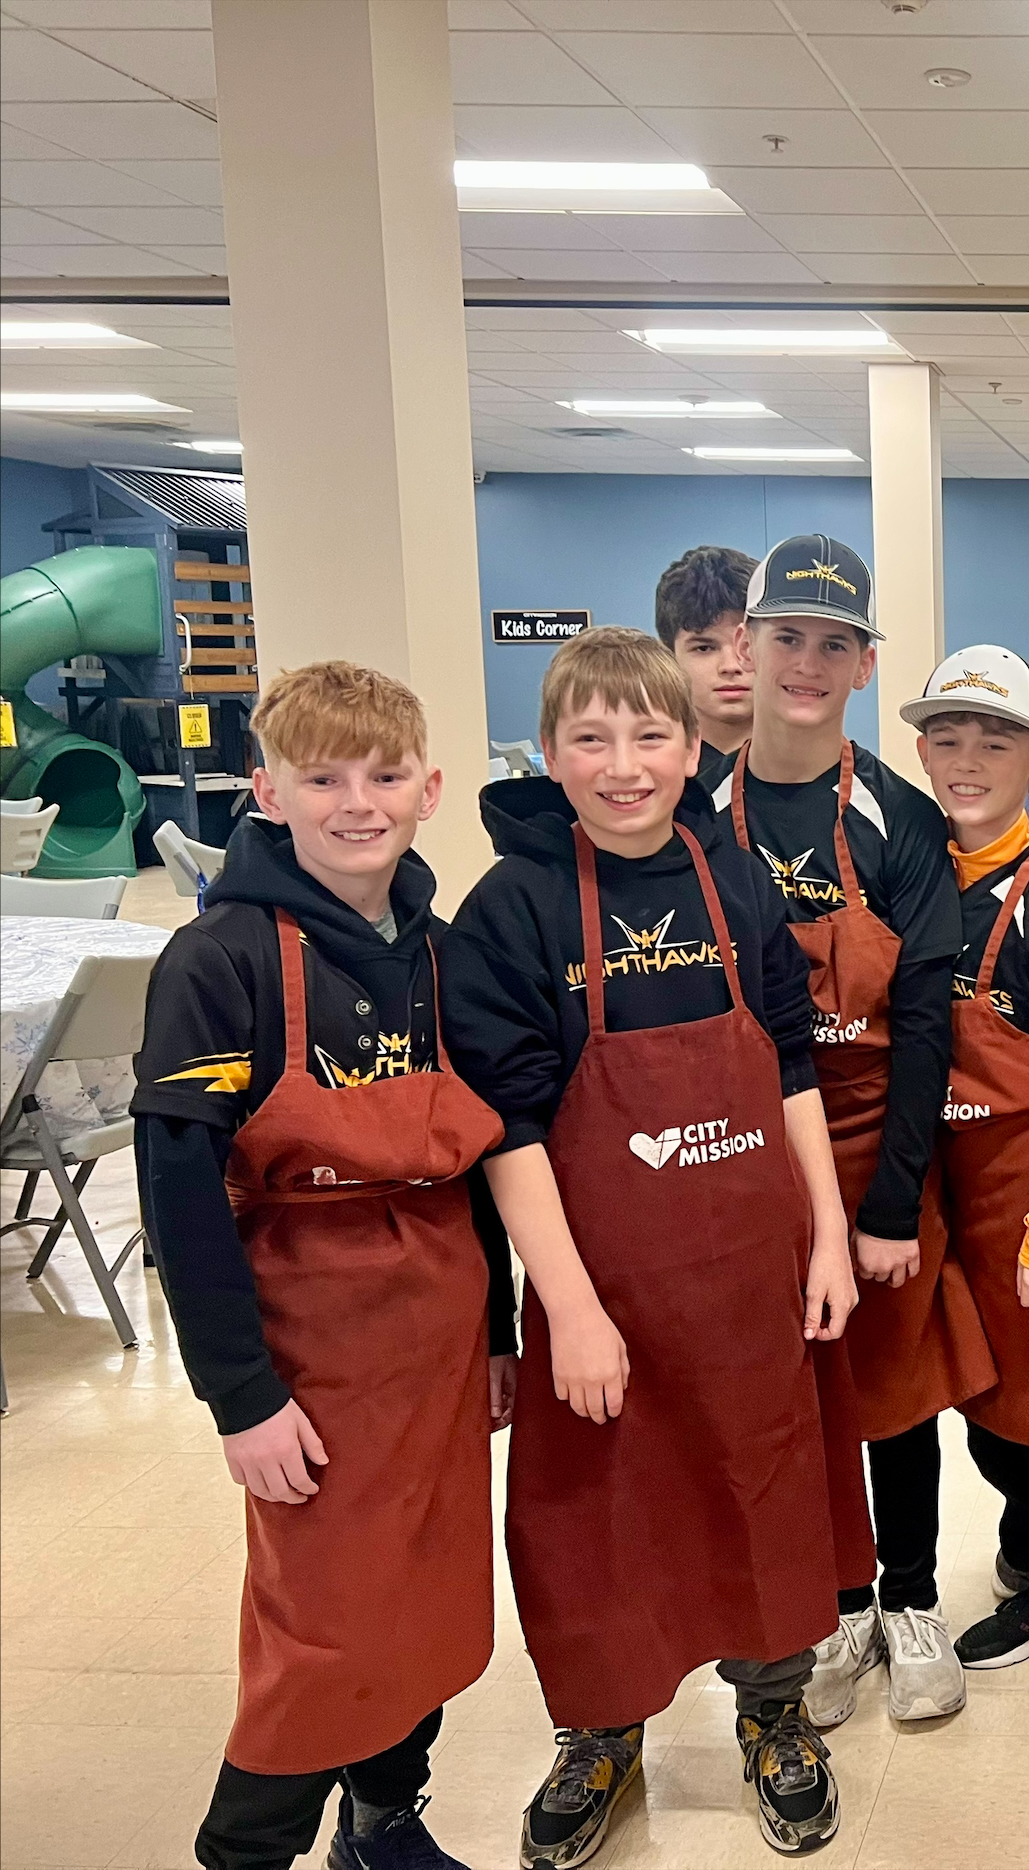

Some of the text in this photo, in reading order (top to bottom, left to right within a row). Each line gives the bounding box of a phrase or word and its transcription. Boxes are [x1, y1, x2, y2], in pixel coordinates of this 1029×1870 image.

[786, 570, 857, 595] NIGHTHAWKS
[501, 619, 583, 637] Kids Corner
[683, 1117, 729, 1143] CITY
[678, 1128, 765, 1167] MISSION
